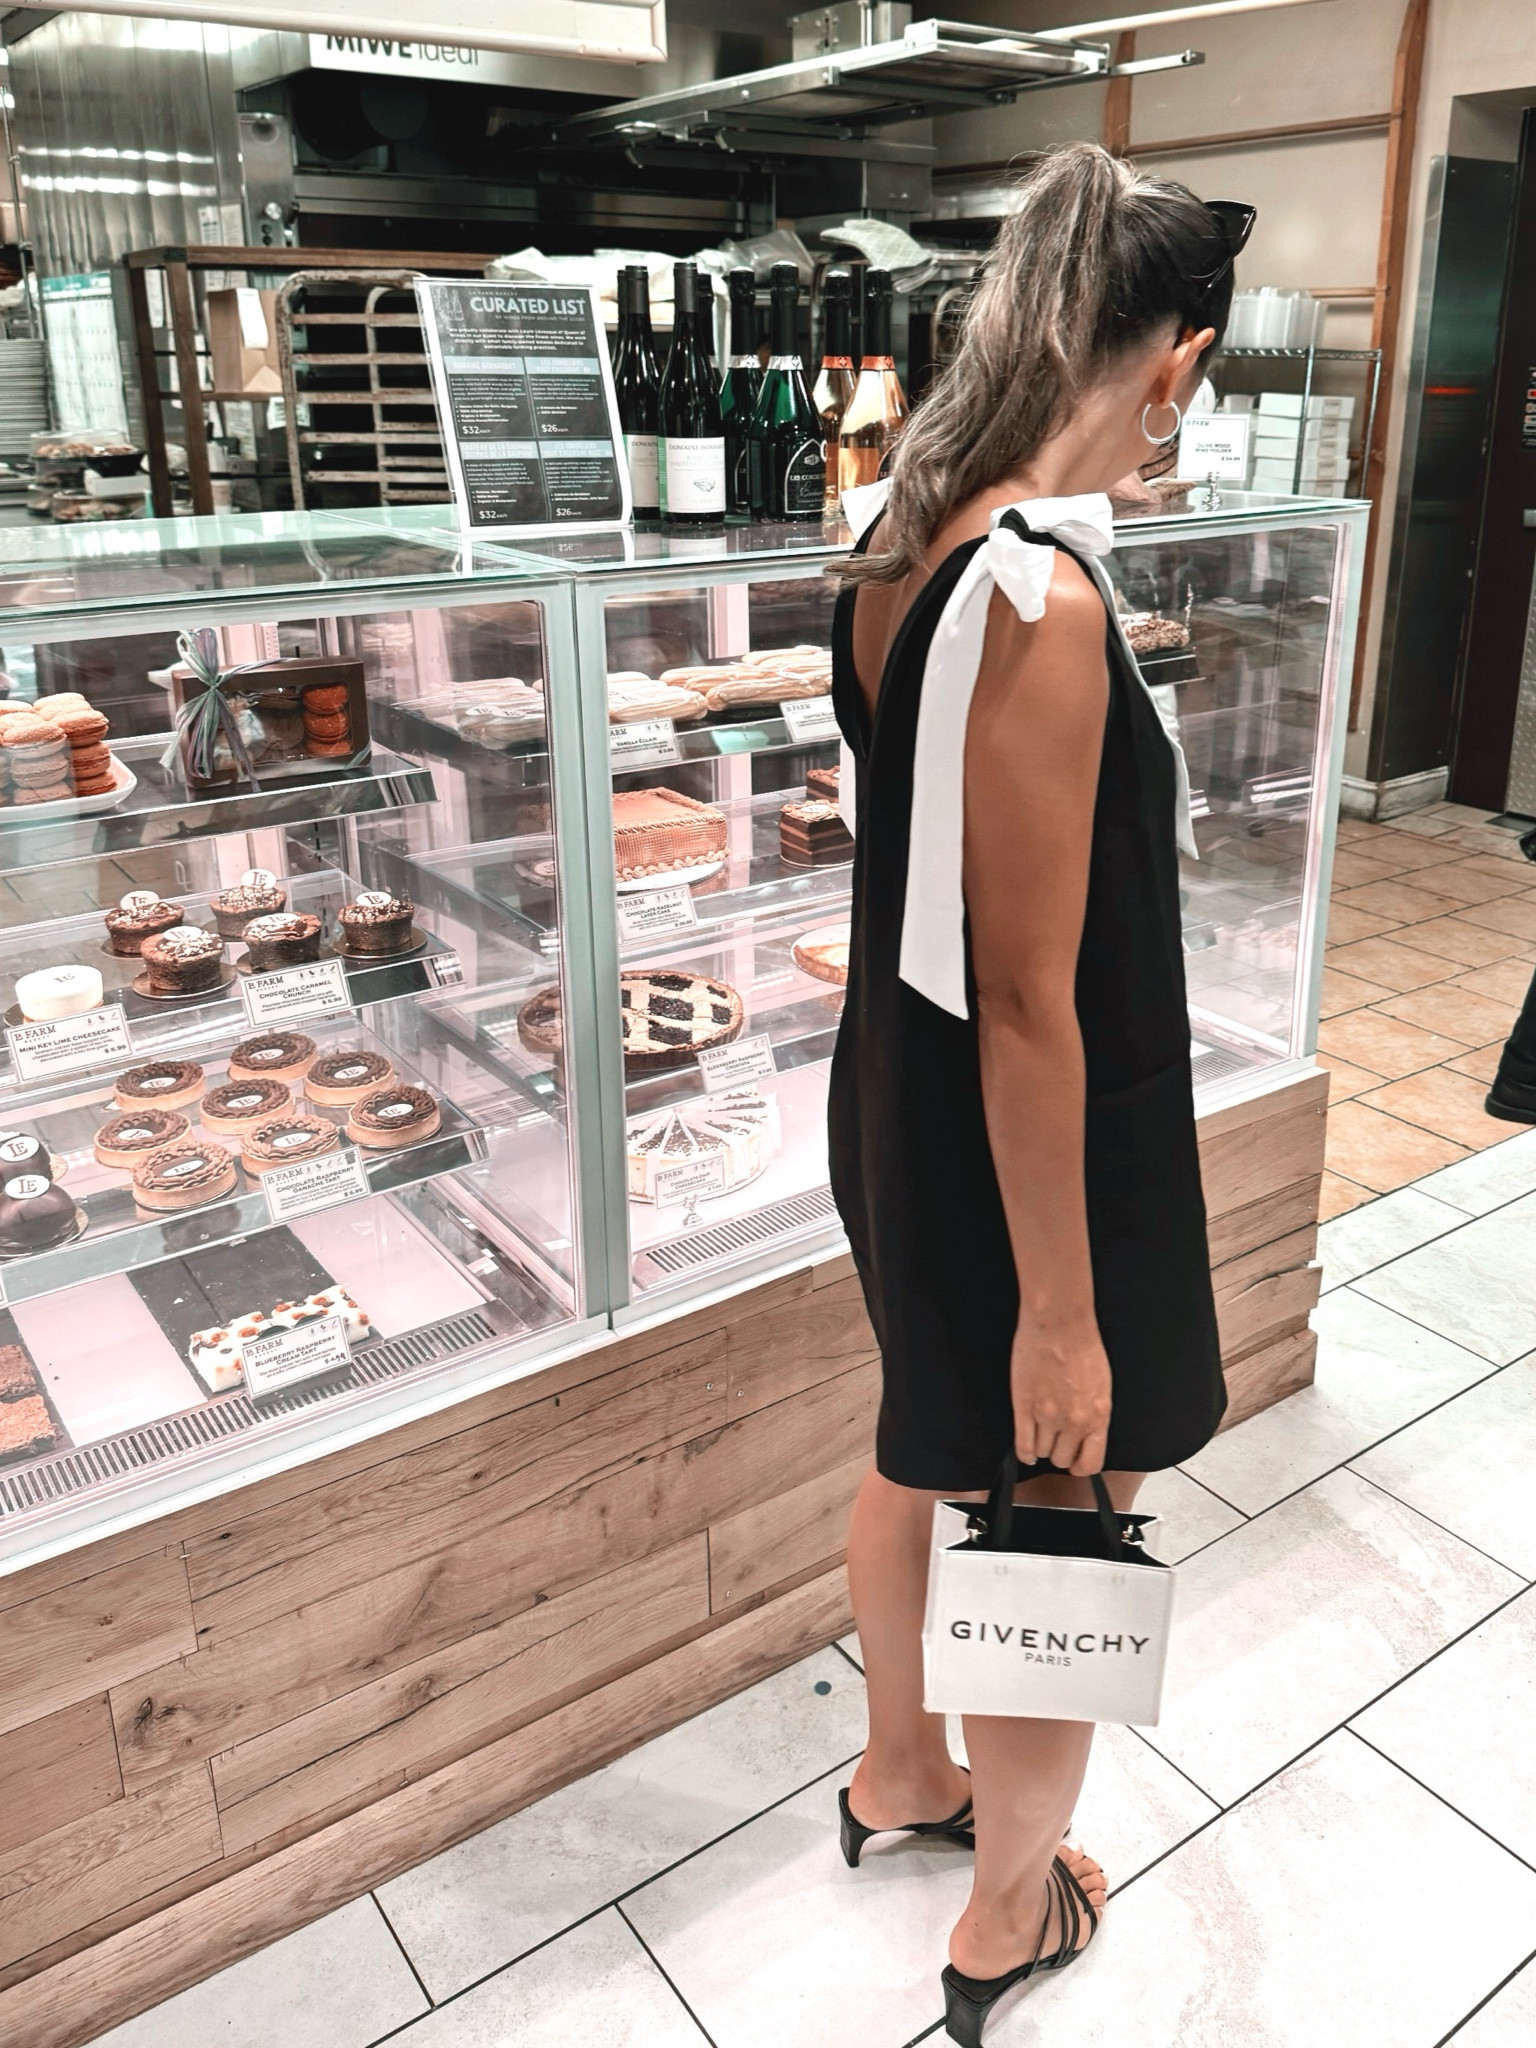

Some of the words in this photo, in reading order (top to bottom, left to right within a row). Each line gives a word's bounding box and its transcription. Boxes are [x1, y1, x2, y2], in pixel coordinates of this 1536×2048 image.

[470, 297, 549, 314] CURATED
[552, 298, 586, 315] LIST
[462, 426, 480, 434] $32
[541, 424, 558, 433] $26
[479, 510, 497, 520] $32
[556, 508, 571, 516] $26
[610, 728, 627, 736] ARM
[253, 871, 268, 886] LE
[364, 894, 383, 904] LE
[624, 898, 645, 908] FARM
[626, 908, 656, 917] CHOCOLATE
[257, 976, 284, 988] FARM
[260, 987, 299, 999] CHOCOLATE
[301, 980, 332, 991] CARAMEL
[283, 990, 311, 999] CRUNCH
[25, 1025, 56, 1038] FARM
[20, 1045, 36, 1053] MINI
[73, 1026, 121, 1041] CHEESECAKE
[111, 1044, 126, 1052] 5.99
[708, 1050, 728, 1059] FARM
[7, 1142, 28, 1157] LE
[276, 1168, 304, 1181] FARM
[277, 1179, 315, 1192] CHOCOLATE
[316, 1166, 354, 1180] RASPBERRY
[664, 1170, 684, 1179] FARM
[671, 1175, 698, 1186] CHOCOLATE
[18, 1179, 37, 1194] LE
[293, 1181, 324, 1193] GANACHE
[325, 1176, 340, 1184] TART
[255, 1339, 282, 1353] FARM
[255, 1350, 295, 1367] BLUEBERRY
[296, 1336, 335, 1351] RASPBERRY
[277, 1354, 300, 1364] CREAM
[301, 1348, 317, 1356] TART
[950, 1620, 1150, 1654] GIVENCHY
[1024, 1652, 1072, 1667] PARIS
